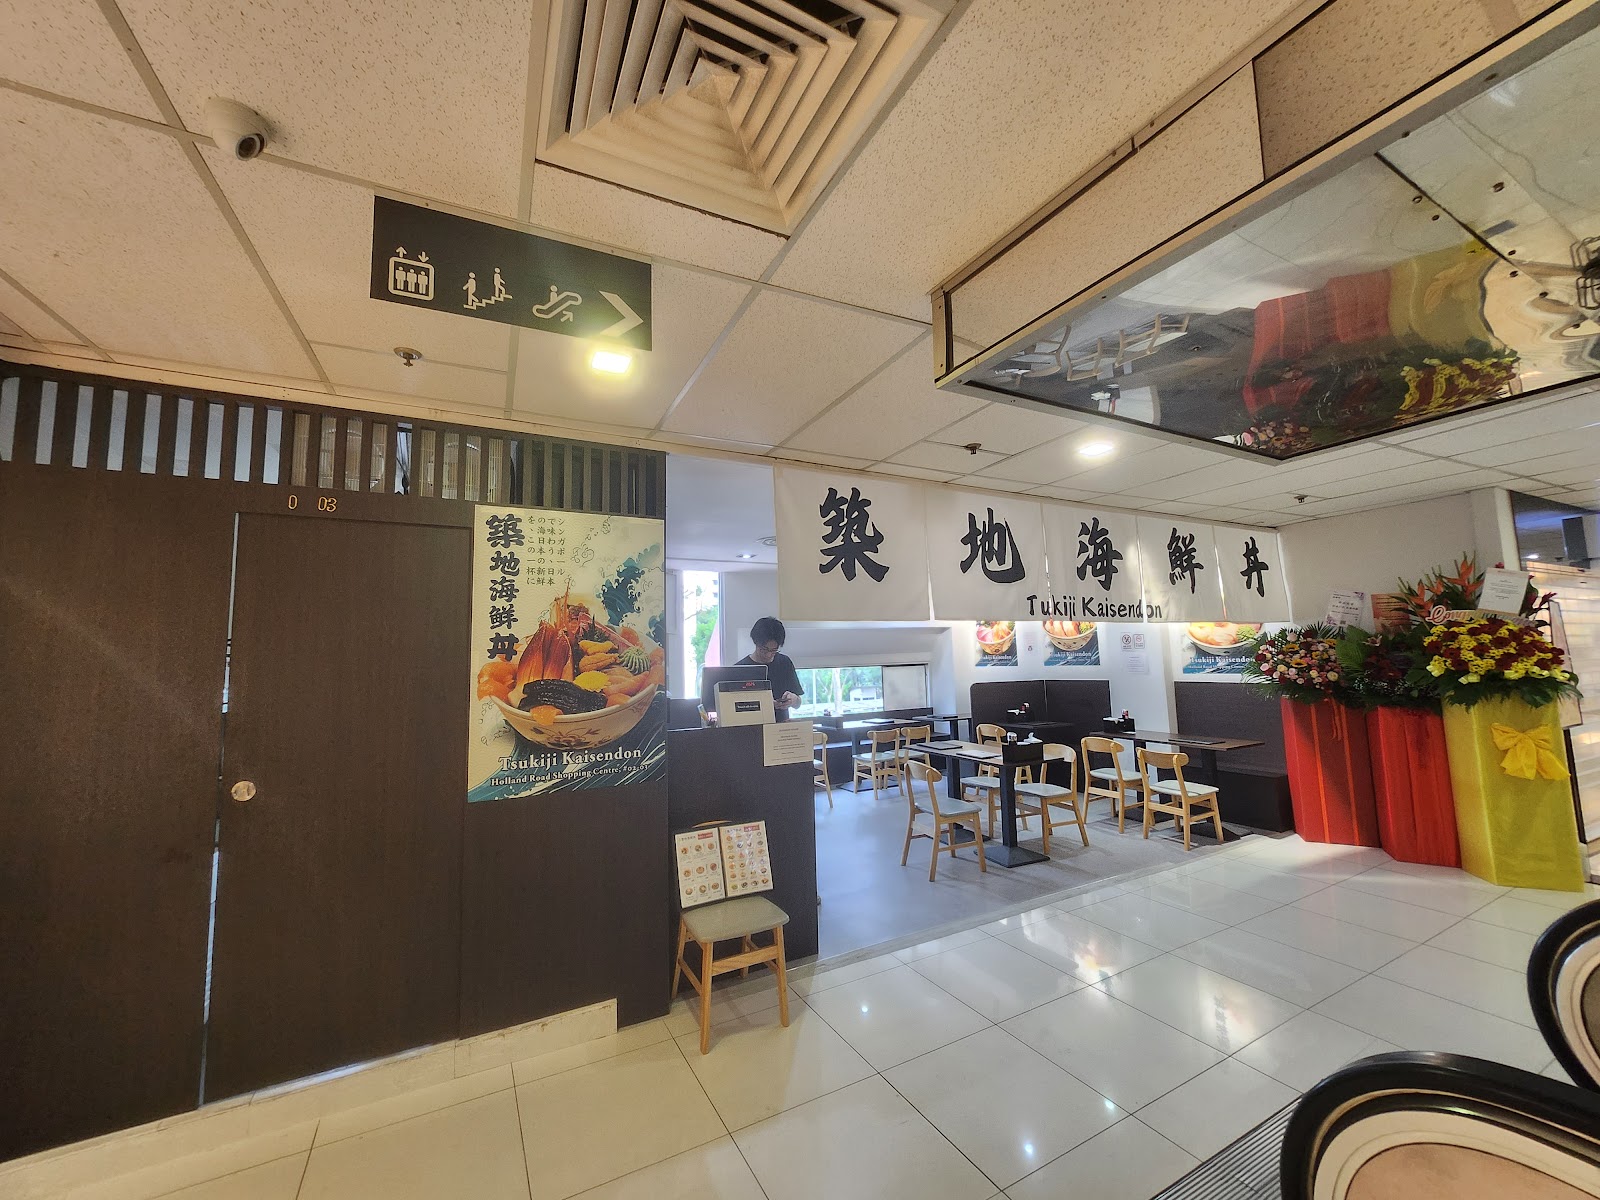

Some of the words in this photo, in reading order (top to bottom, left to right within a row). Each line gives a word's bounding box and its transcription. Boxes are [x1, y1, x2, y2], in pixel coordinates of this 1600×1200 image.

[288, 494, 298, 510] 0
[317, 496, 337, 512] 03
[818, 486, 1269, 598] 築地海鮮丼
[485, 513, 525, 662] 築地海鮮丼
[1026, 594, 1076, 621] Tukiji
[1081, 596, 1163, 619] Kaisendon
[498, 752, 558, 771] Tsukiji
[562, 746, 642, 766] Kaisendon
[490, 774, 527, 786] Holland
[530, 773, 551, 783] Road
[552, 769, 592, 781] Shopping
